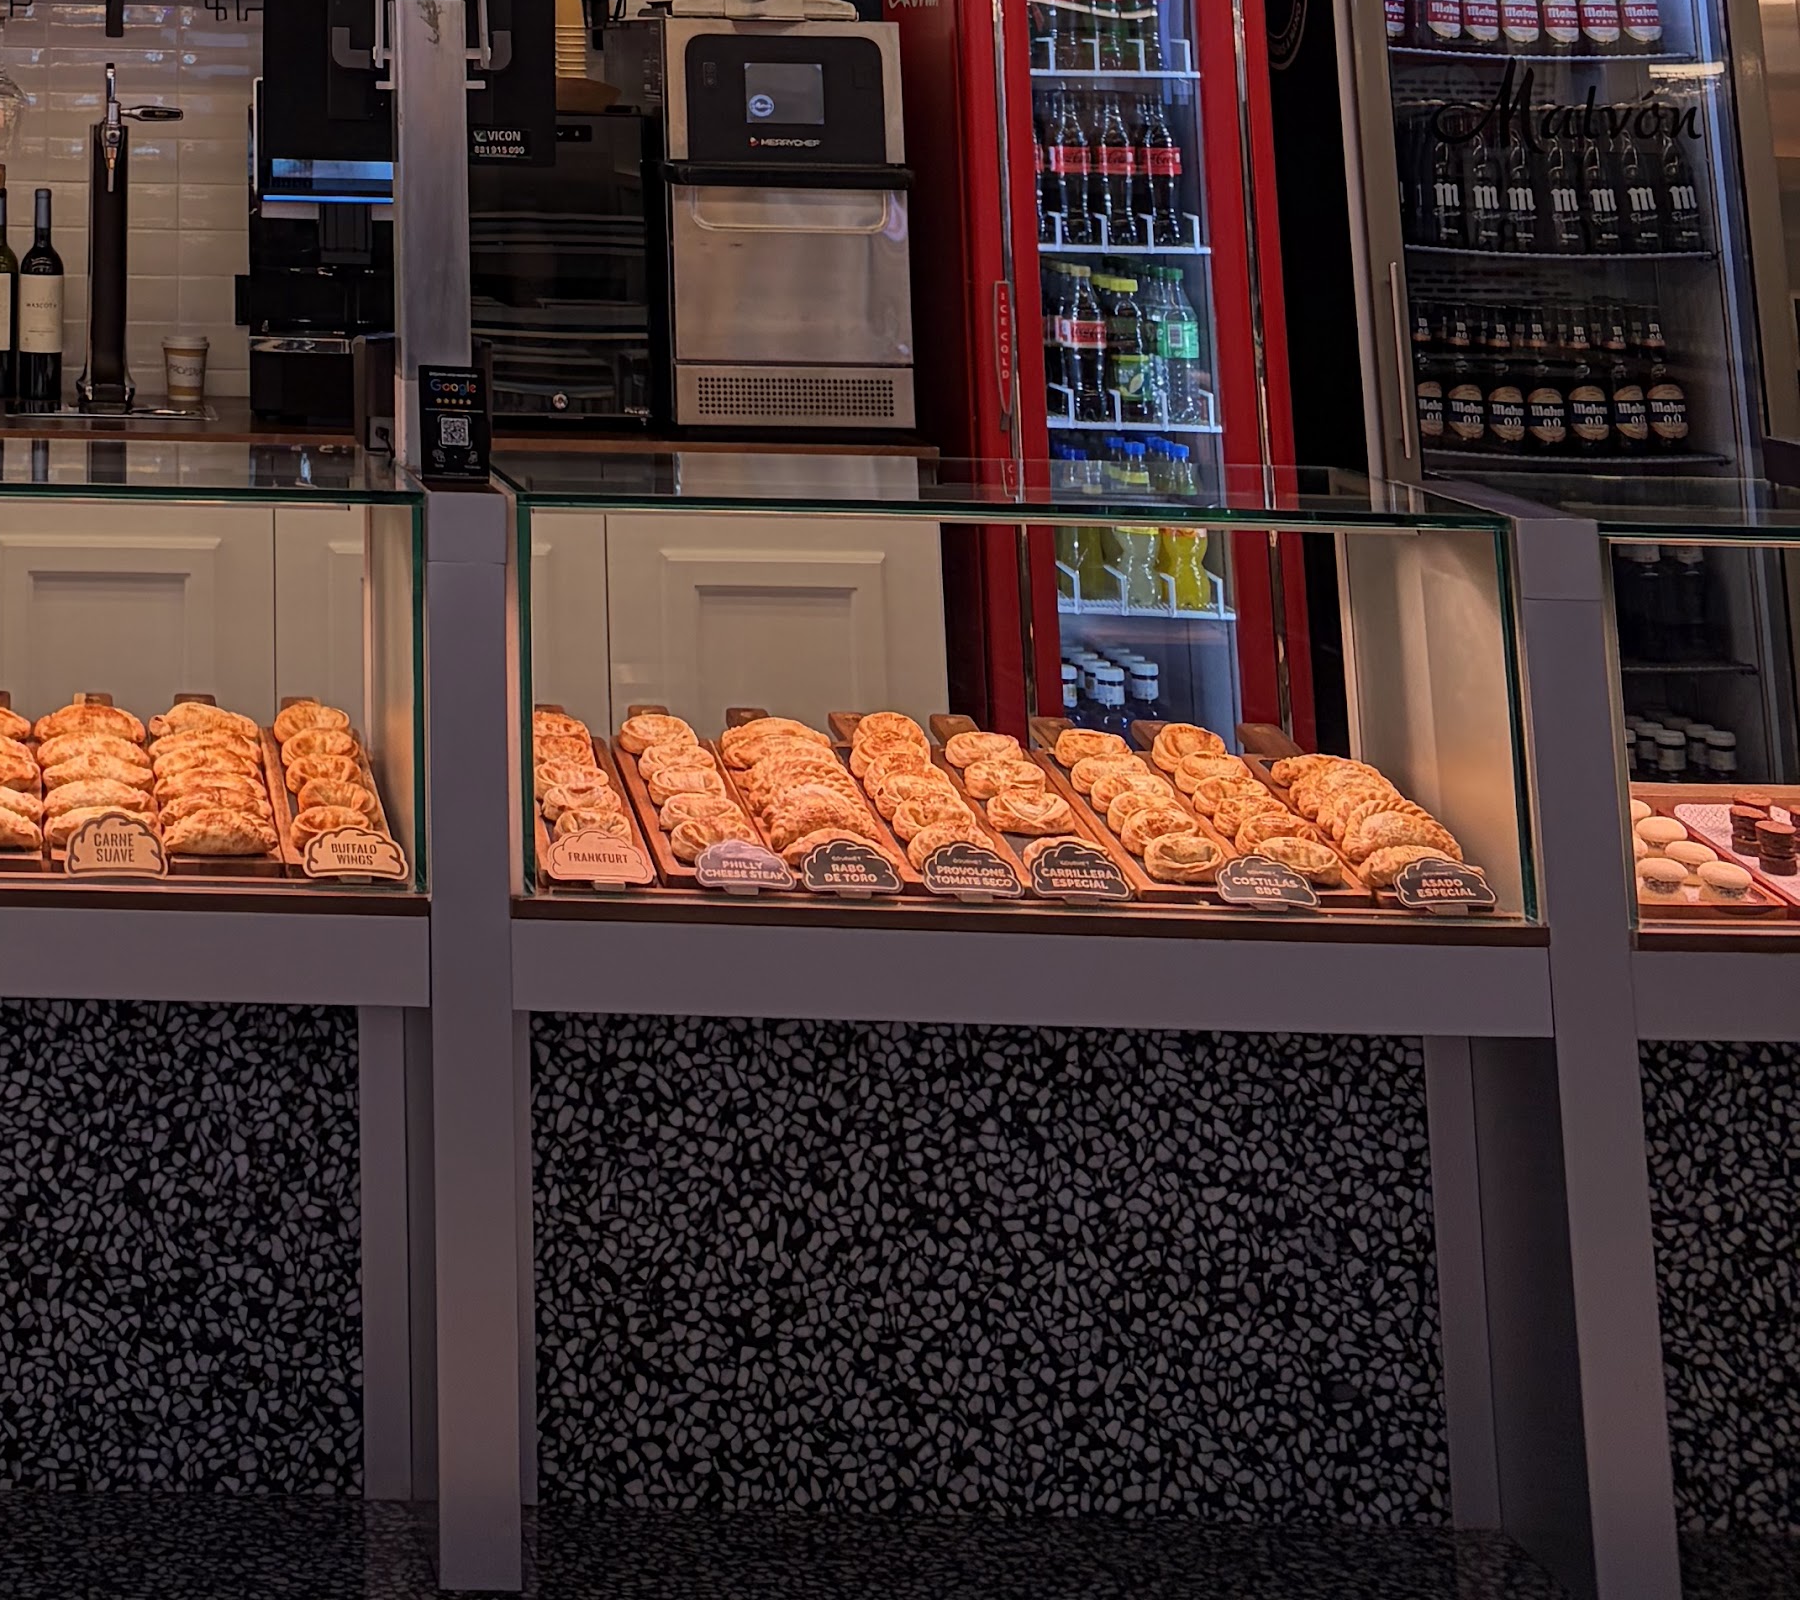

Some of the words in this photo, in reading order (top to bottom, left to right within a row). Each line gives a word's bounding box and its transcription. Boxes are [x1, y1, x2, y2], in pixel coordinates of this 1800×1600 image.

[1431, 57, 1702, 153] Malvón
[487, 131, 521, 141] VICON
[430, 379, 477, 396] Google
[94, 833, 134, 848] CARNE
[331, 842, 377, 855] BUFFALO
[96, 848, 135, 863] SUAVE
[337, 853, 373, 866] WINGS
[568, 851, 628, 864] FRANKFURT
[722, 860, 763, 870] PHILLY
[831, 863, 866, 873] RABO
[936, 866, 1005, 877] PROVOLONE
[705, 869, 747, 879] CHEESE
[749, 869, 785, 881] STEAK
[824, 873, 842, 882] DE
[844, 874, 878, 883] TORO
[1040, 867, 1114, 880] CARRILLERA
[935, 875, 980, 886] TOMATE
[982, 877, 1013, 888] SECO
[1052, 878, 1109, 890] ESPECIAL
[1232, 876, 1298, 889] COSTILLAS
[1421, 877, 1463, 888] ASADO
[1416, 887, 1476, 898] ESPECIAL
